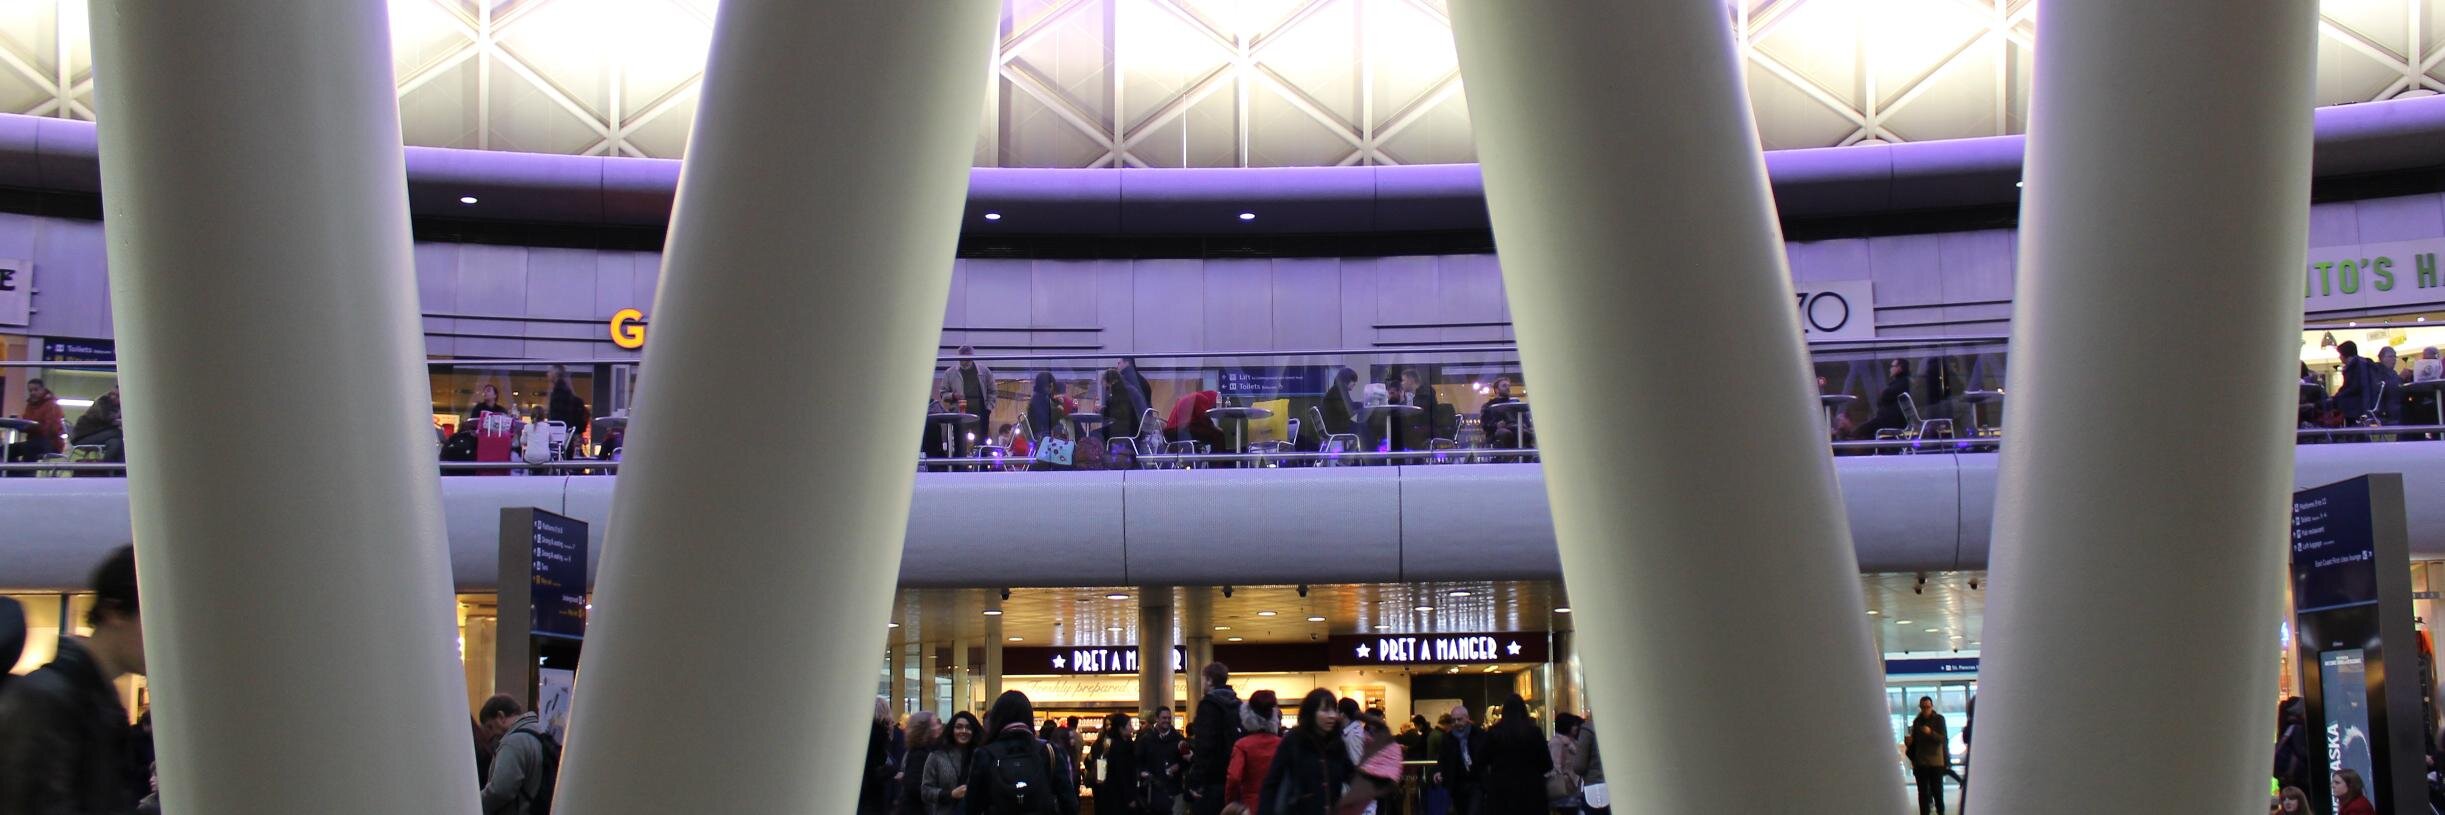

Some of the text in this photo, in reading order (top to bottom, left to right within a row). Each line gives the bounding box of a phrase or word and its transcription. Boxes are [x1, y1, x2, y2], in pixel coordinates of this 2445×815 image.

[610, 308, 645, 349] G
[1074, 649, 1107, 671] PRET
[1111, 650, 1121, 671] A
[1379, 637, 1416, 661] PRET
[1420, 638, 1431, 660] A
